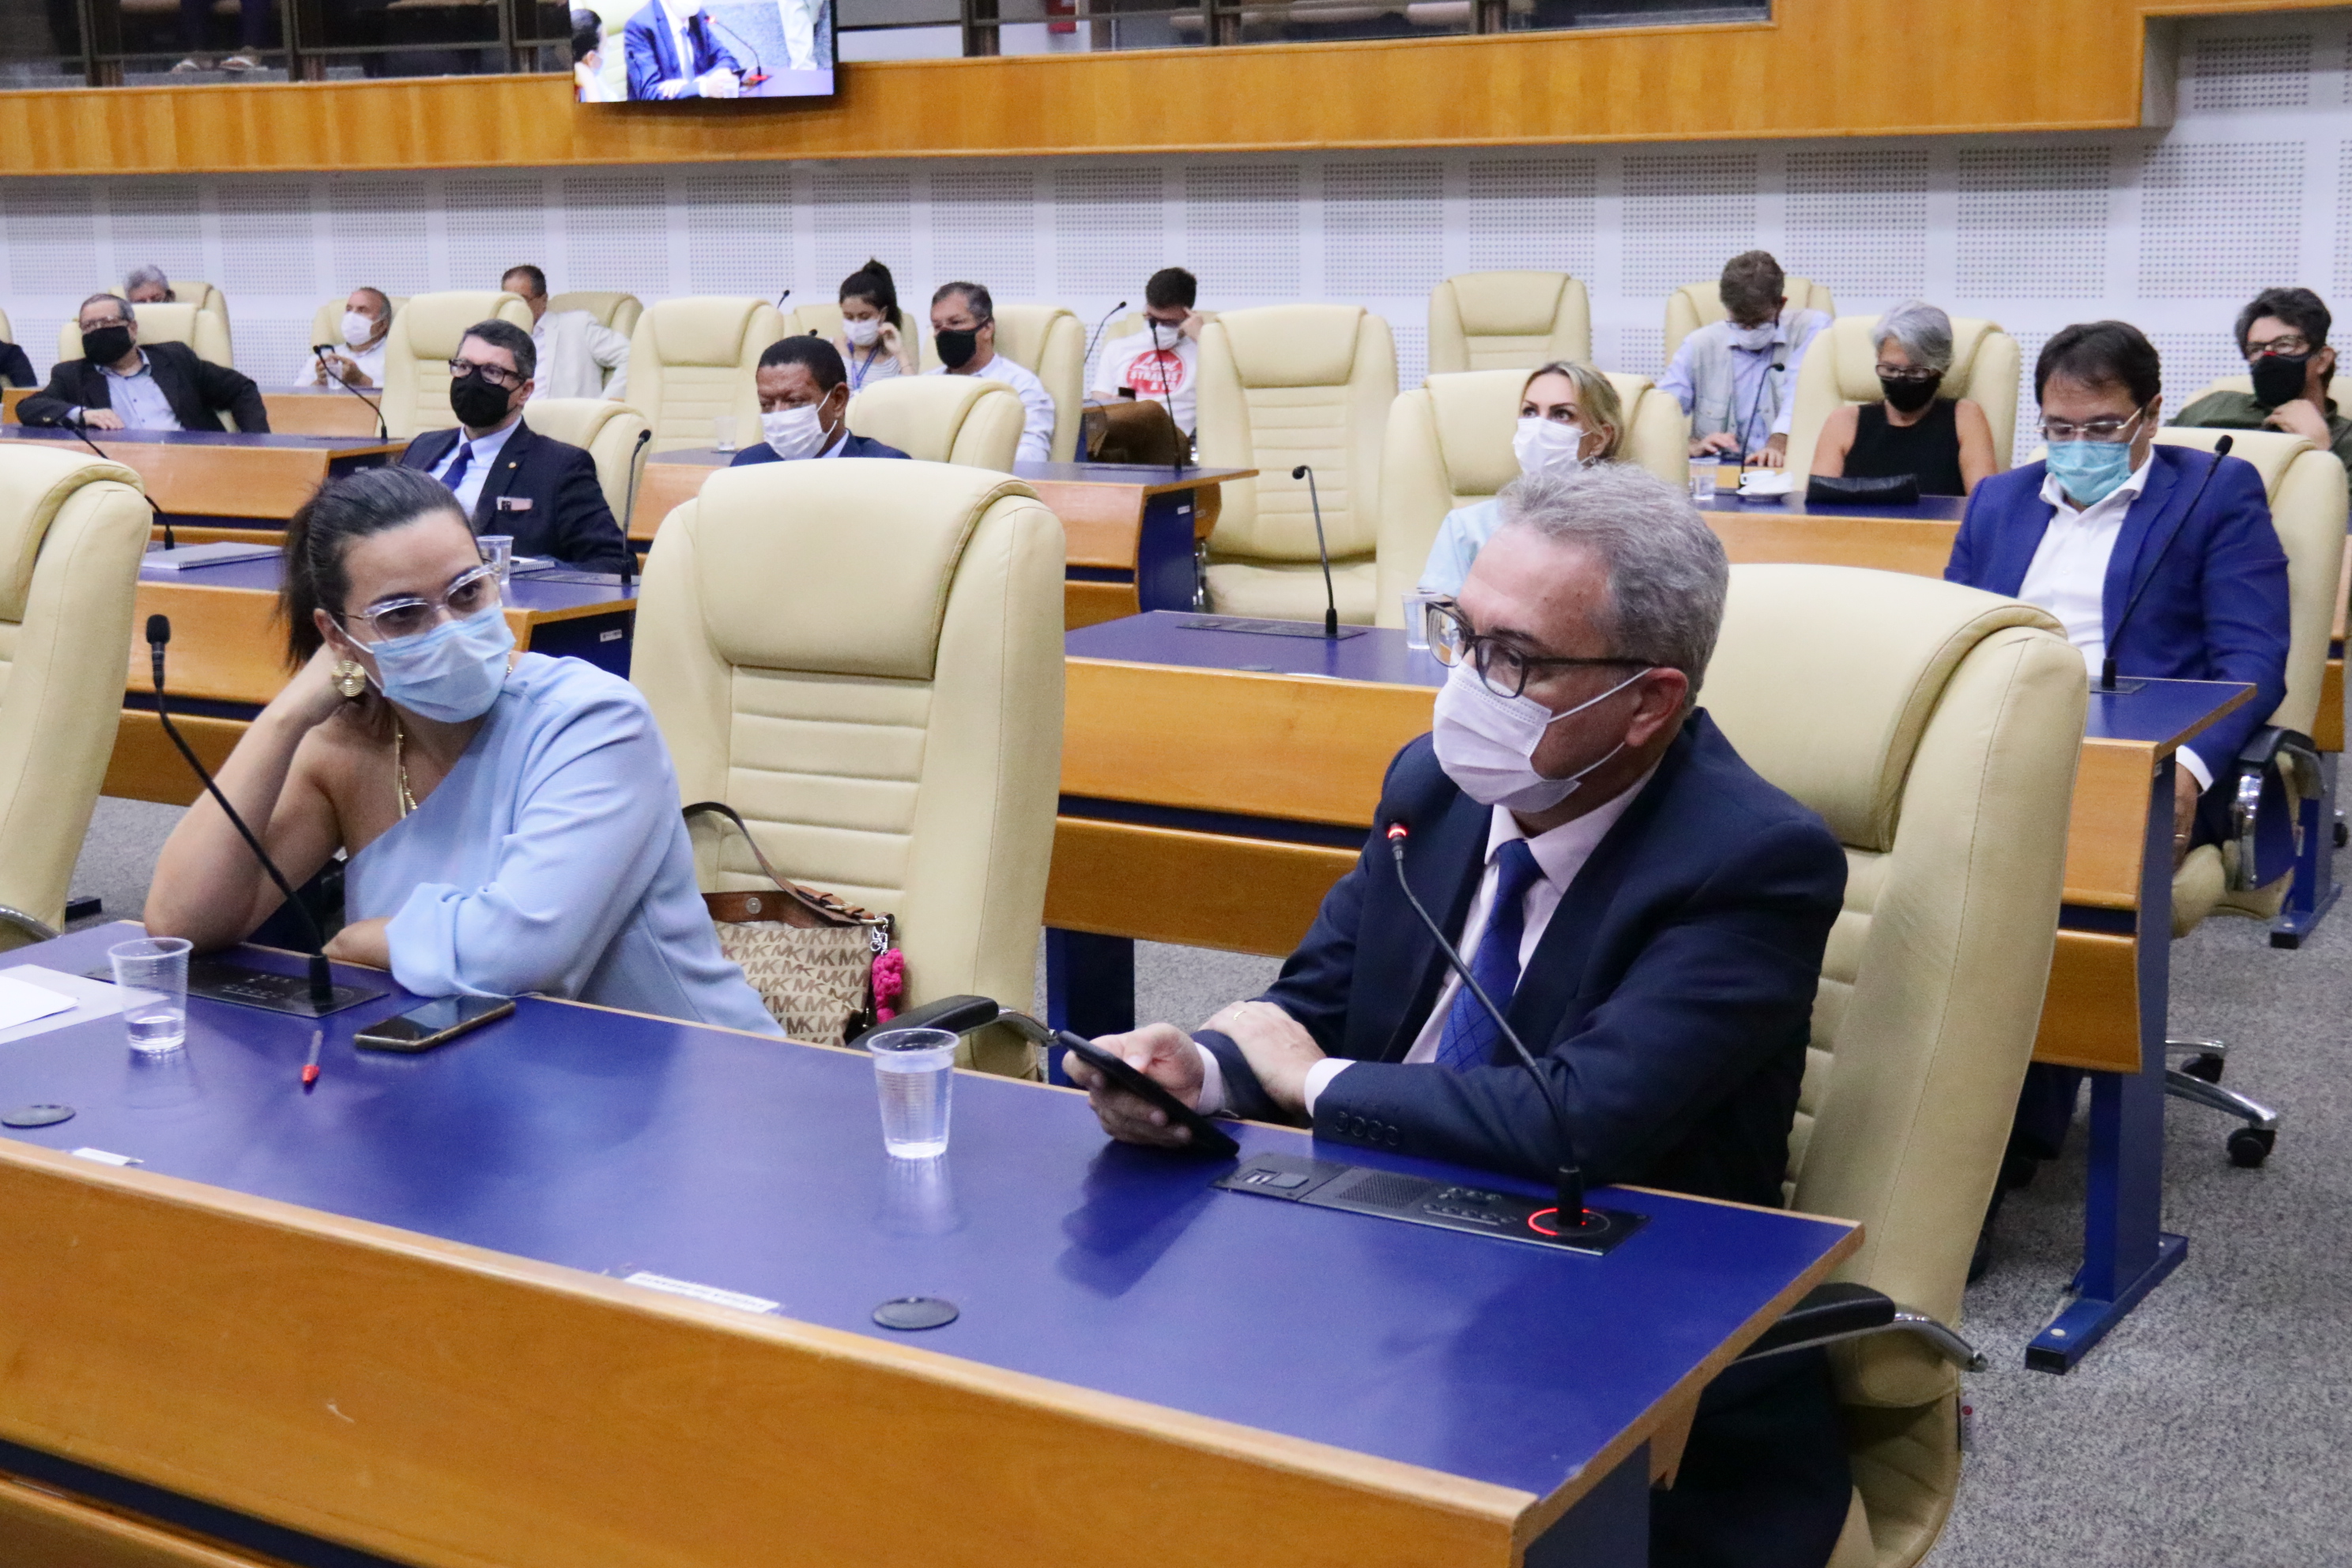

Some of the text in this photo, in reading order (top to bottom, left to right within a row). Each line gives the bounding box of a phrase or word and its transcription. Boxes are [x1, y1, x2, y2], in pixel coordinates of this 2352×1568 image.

[729, 926, 764, 944] MK
[763, 930, 796, 943] MK
[795, 929, 827, 945] MK
[828, 928, 857, 945] MK
[721, 944, 869, 966] K MK MK MK MK
[748, 959, 869, 988] MK MK MK M
[759, 977, 859, 1008] MK MK MK
[773, 996, 802, 1014] MK
[805, 996, 838, 1013] MK
[786, 1016, 815, 1035] MK
